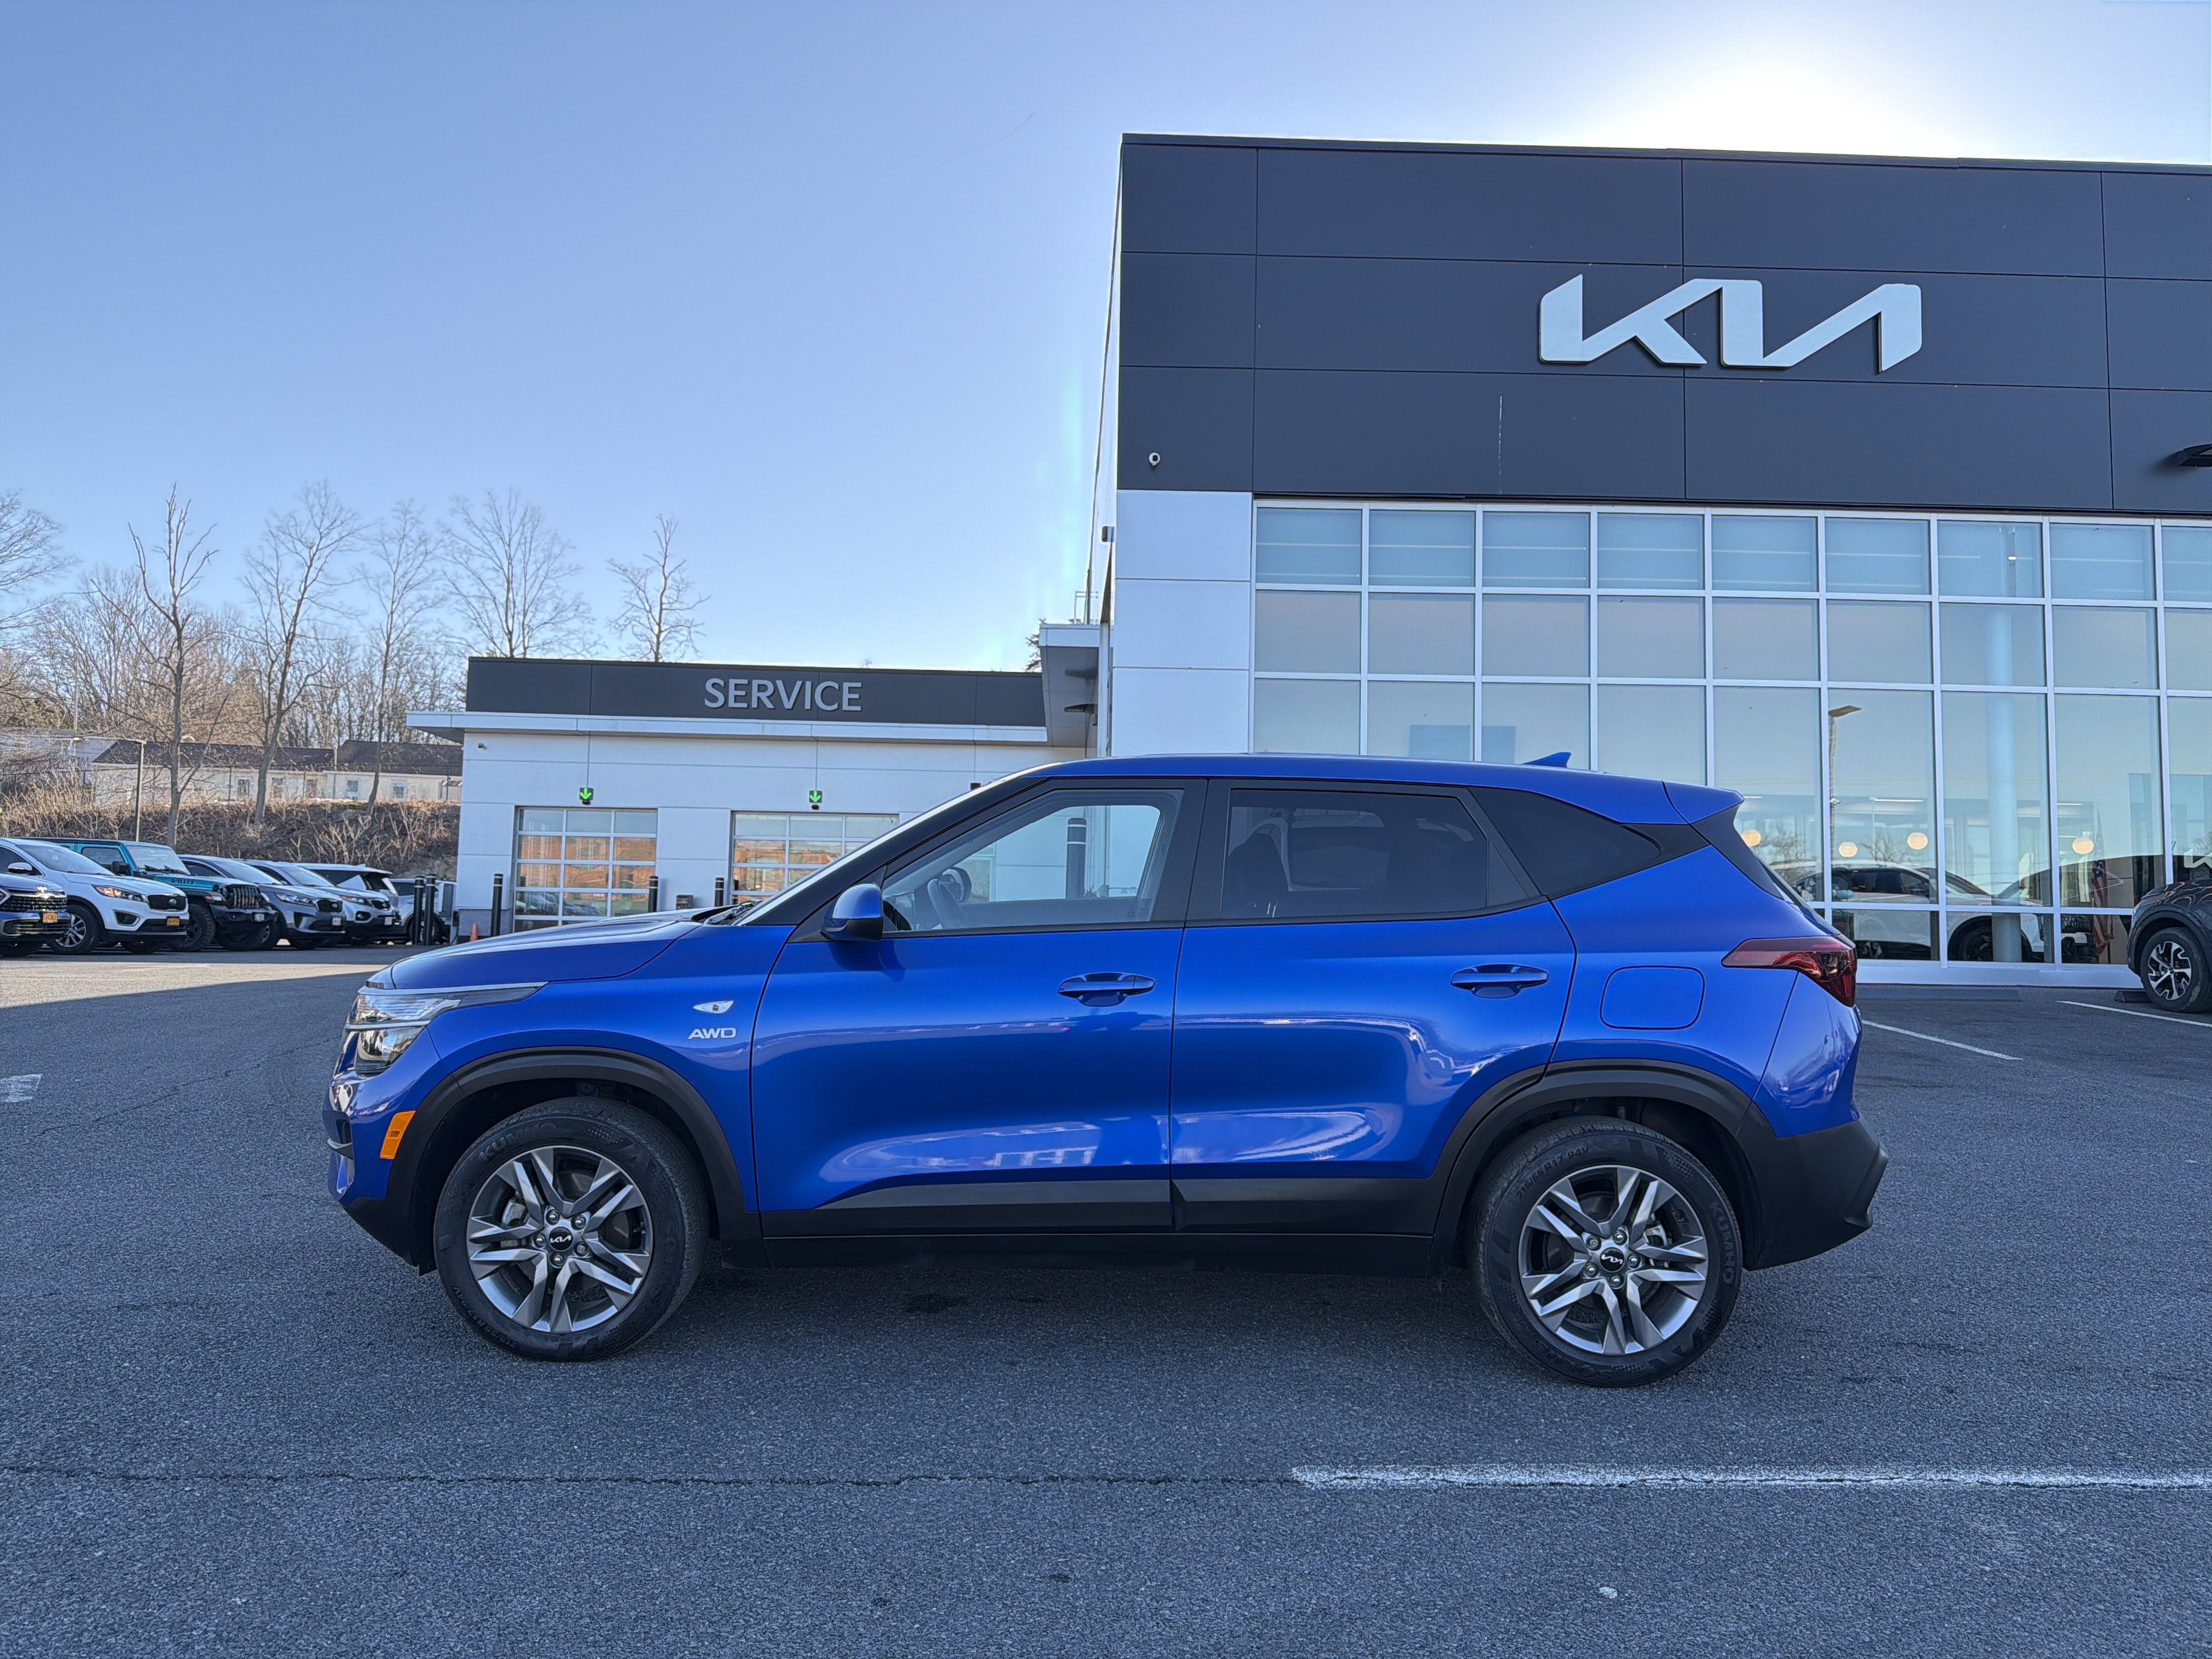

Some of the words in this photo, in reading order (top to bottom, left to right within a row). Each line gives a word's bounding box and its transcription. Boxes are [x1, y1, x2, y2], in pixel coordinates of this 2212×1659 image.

[1539, 274, 1922, 373] KIA
[704, 678, 862, 712] SERVICE
[687, 1028, 736, 1040] AWD
[1708, 1200, 1735, 1284] KUMHO
